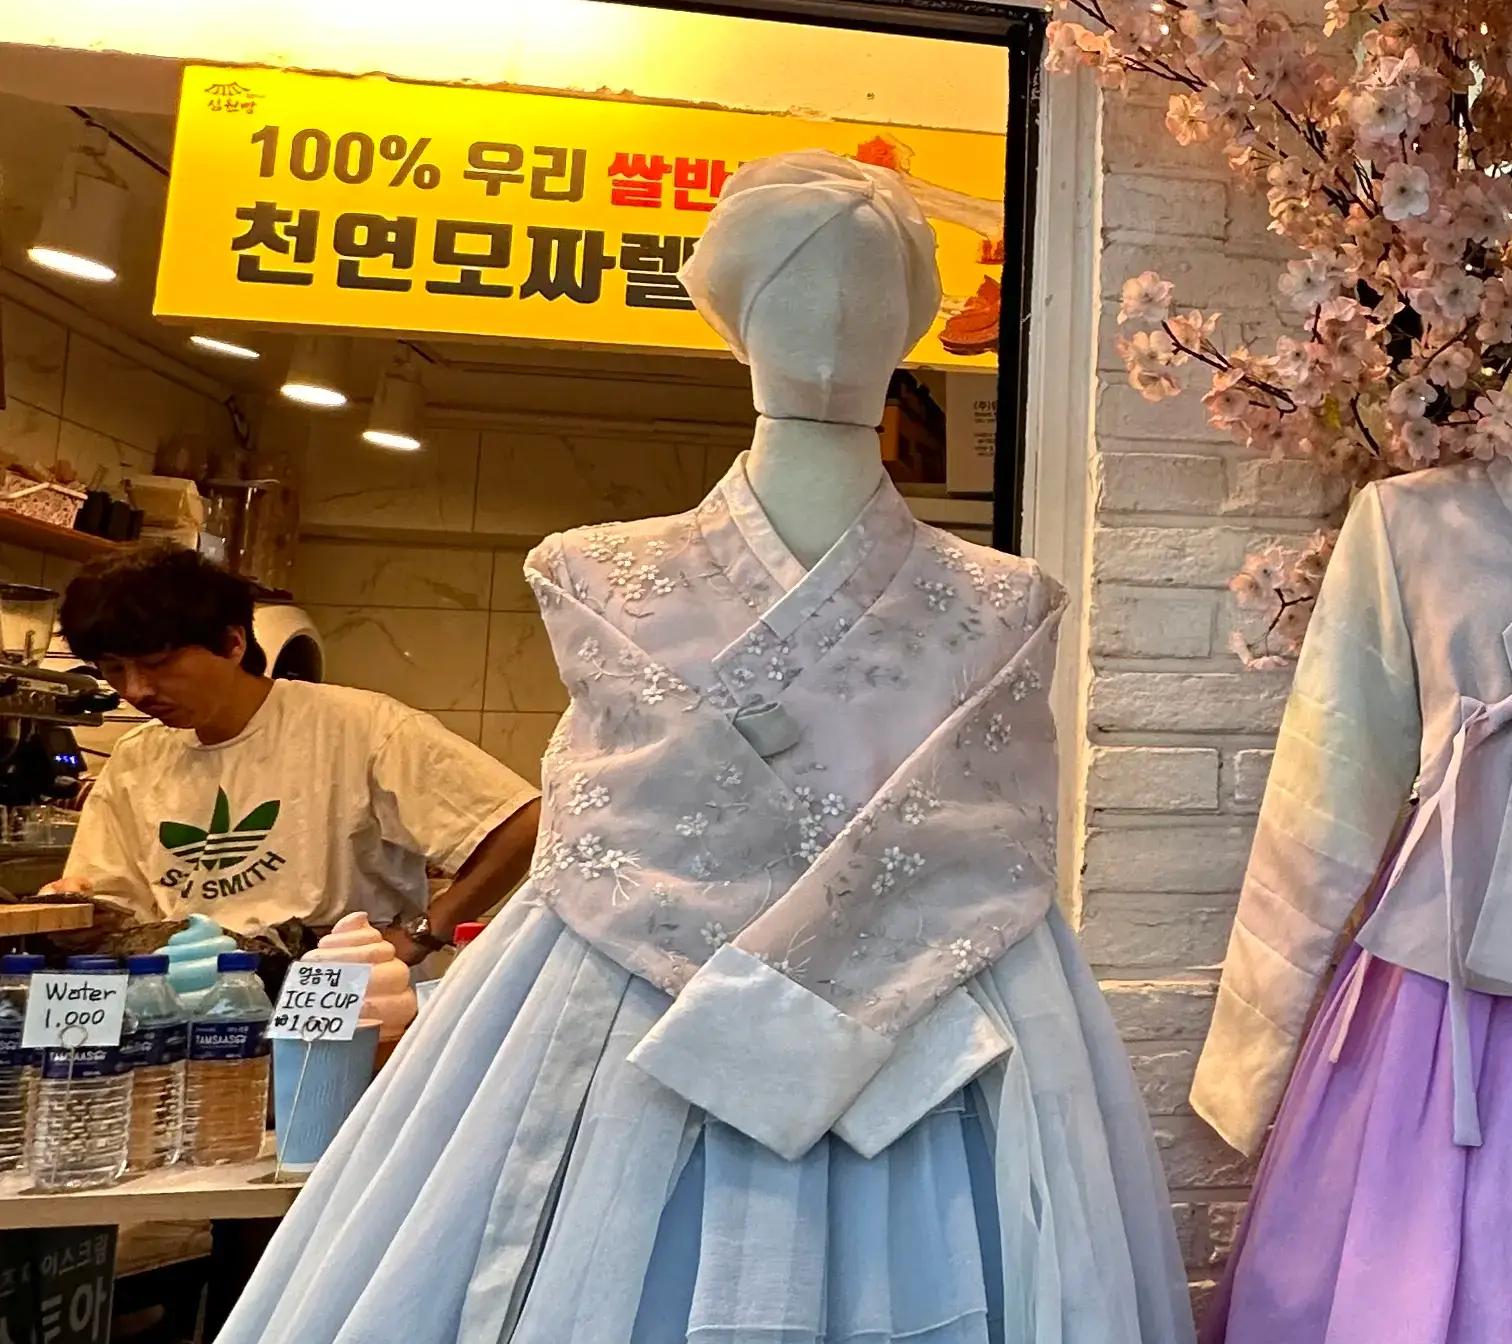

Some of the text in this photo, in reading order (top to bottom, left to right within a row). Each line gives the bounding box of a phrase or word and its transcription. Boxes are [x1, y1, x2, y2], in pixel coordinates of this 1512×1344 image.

[250, 124, 441, 191] 100%
[463, 141, 586, 204] 우리
[202, 851, 286, 899] SMITH
[299, 966, 341, 987] 얼음컵
[46, 980, 116, 1002] Water
[282, 990, 359, 1010] ICE CUP
